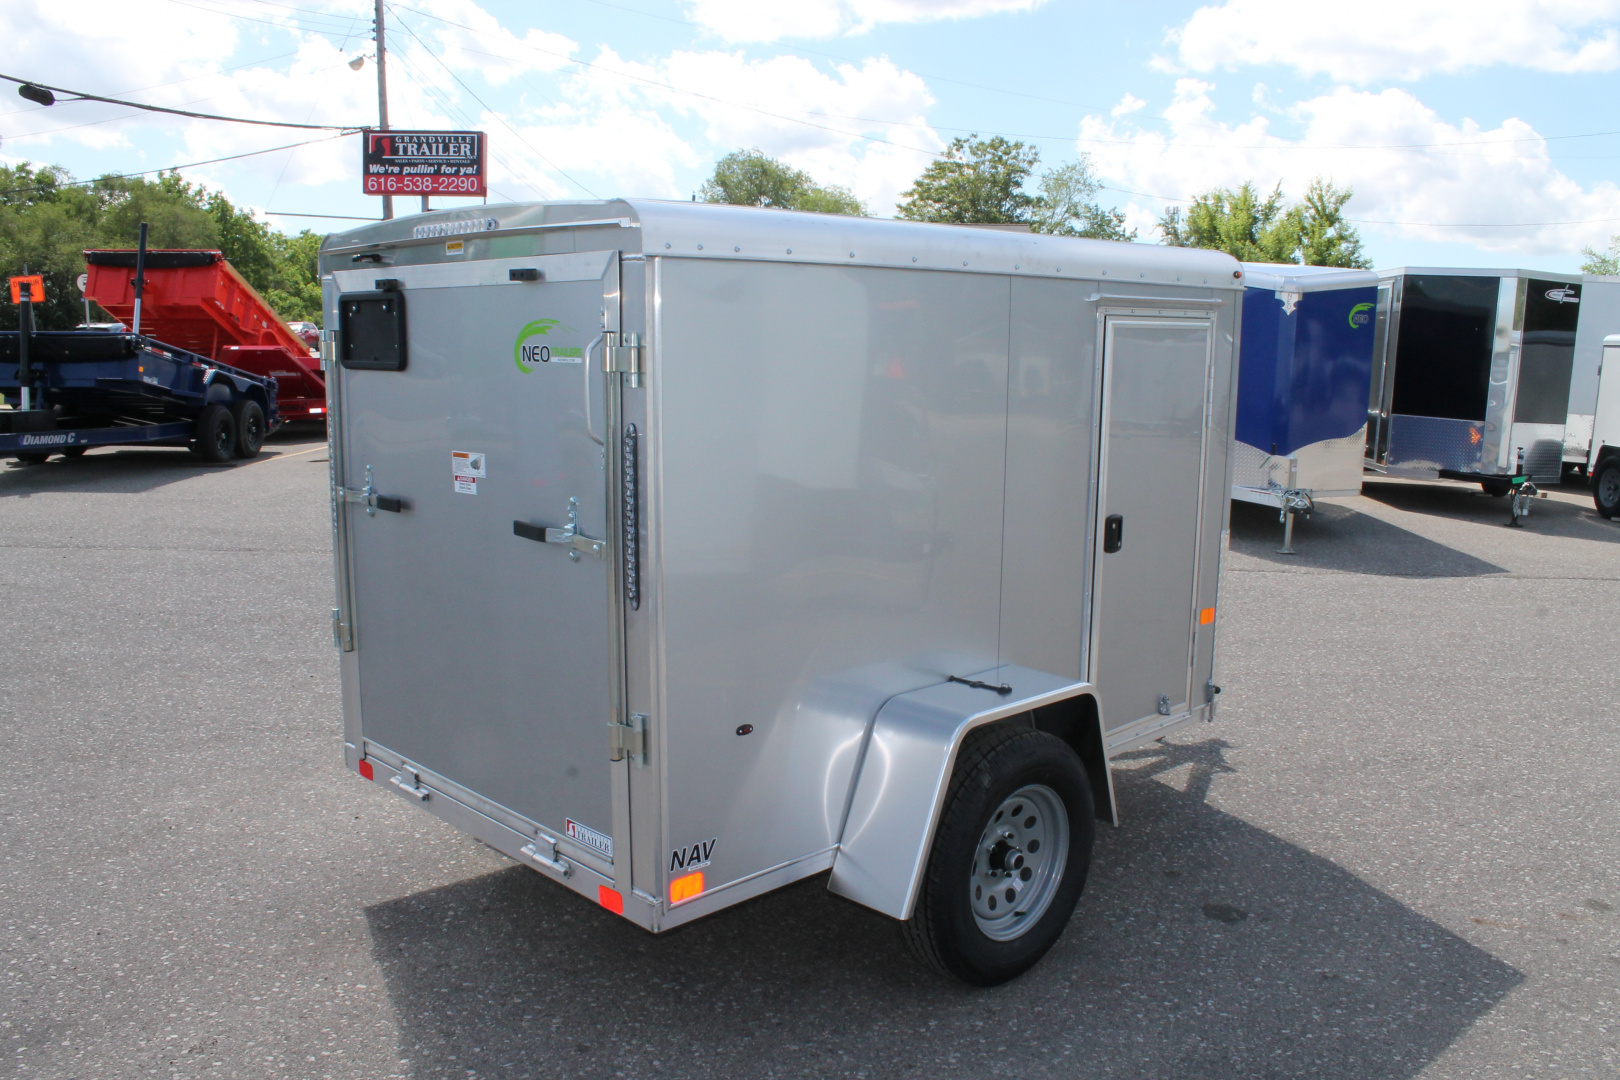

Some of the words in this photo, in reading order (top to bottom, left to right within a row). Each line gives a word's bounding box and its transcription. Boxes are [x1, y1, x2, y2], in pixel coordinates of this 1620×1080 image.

[395, 143, 471, 156] TRAILER
[369, 164, 400, 174] We're
[403, 165, 437, 175] pullin'
[440, 165, 457, 174] for
[459, 165, 477, 175] ya!
[368, 177, 477, 191] 616-538-2290
[522, 345, 550, 362] NEO
[551, 347, 583, 357] TRAILERS
[23, 434, 67, 445] DIAMOND
[67, 432, 75, 443] C
[576, 830, 610, 853] TRAILER
[670, 838, 717, 871] NAV
